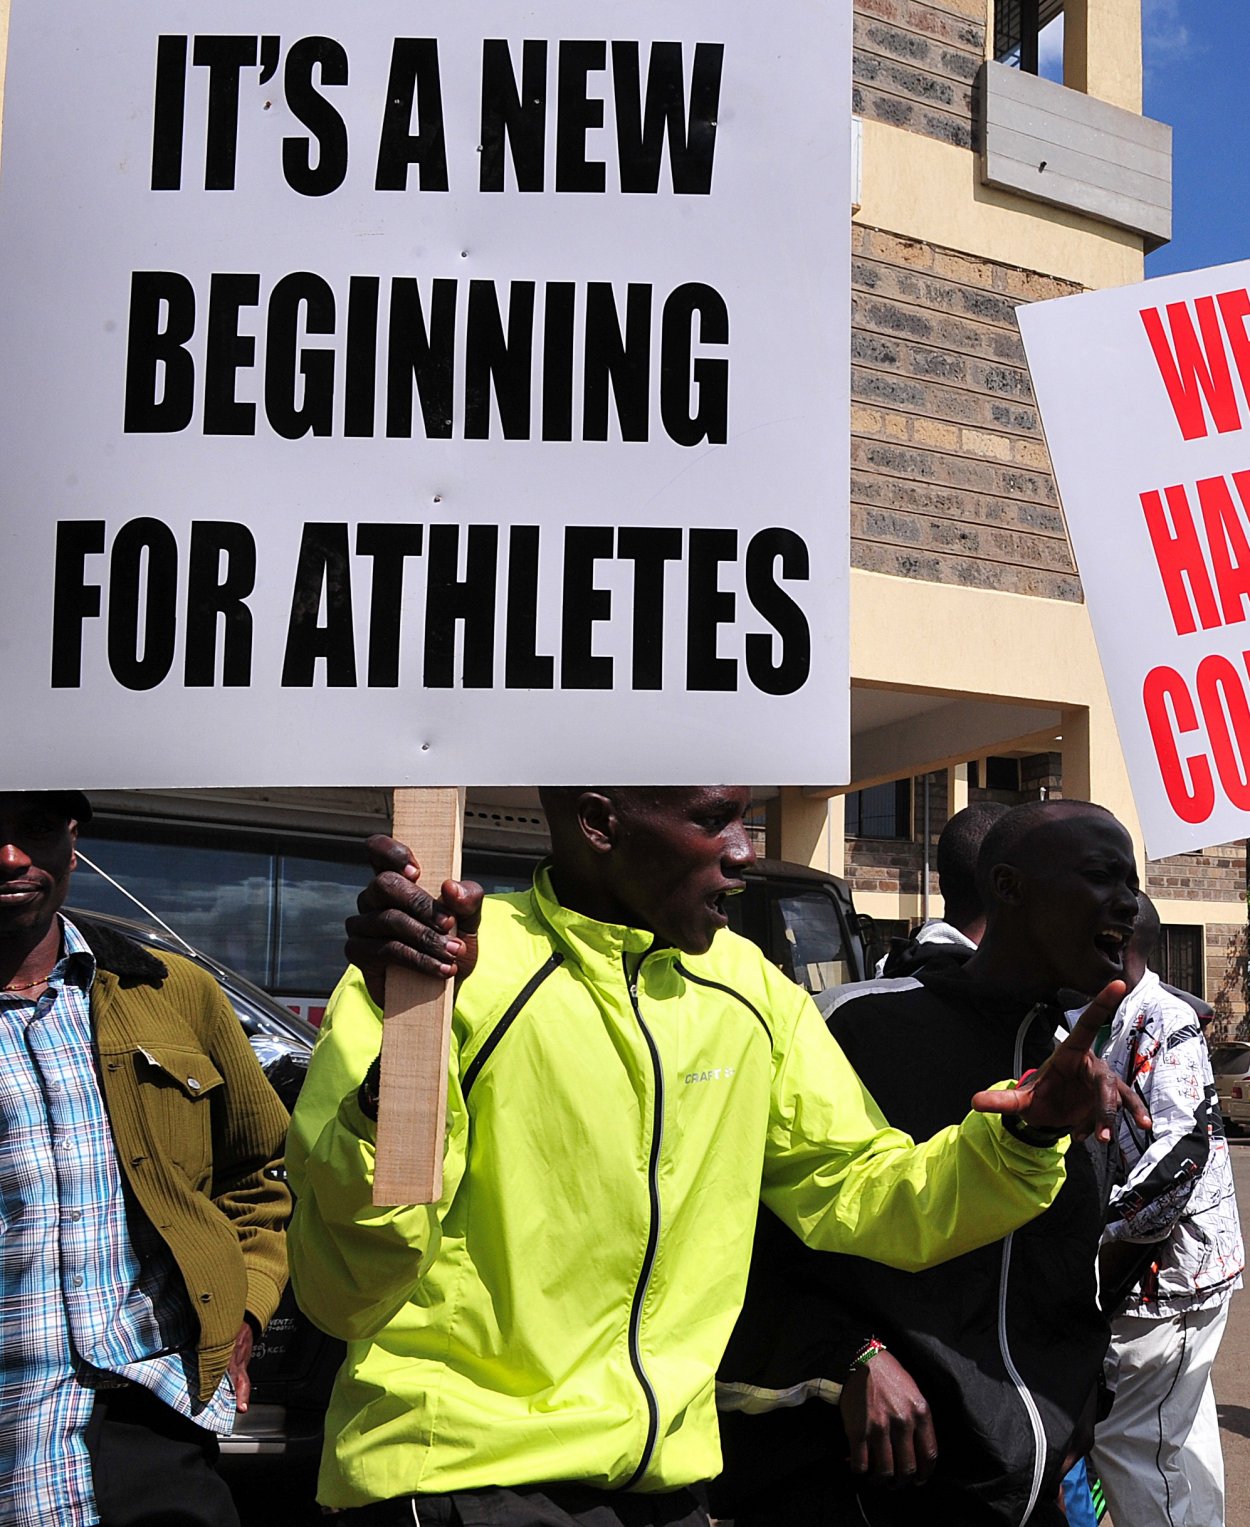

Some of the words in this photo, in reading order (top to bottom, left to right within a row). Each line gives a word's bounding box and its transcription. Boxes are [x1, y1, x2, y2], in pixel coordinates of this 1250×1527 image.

[151, 35, 348, 196] IT'S
[375, 38, 448, 191] A
[478, 39, 724, 194] NEW
[124, 272, 728, 446] BEGINNING
[52, 517, 256, 691] FOR
[281, 523, 810, 695] ATHLETES
[685, 1068, 721, 1084] CRAFT
